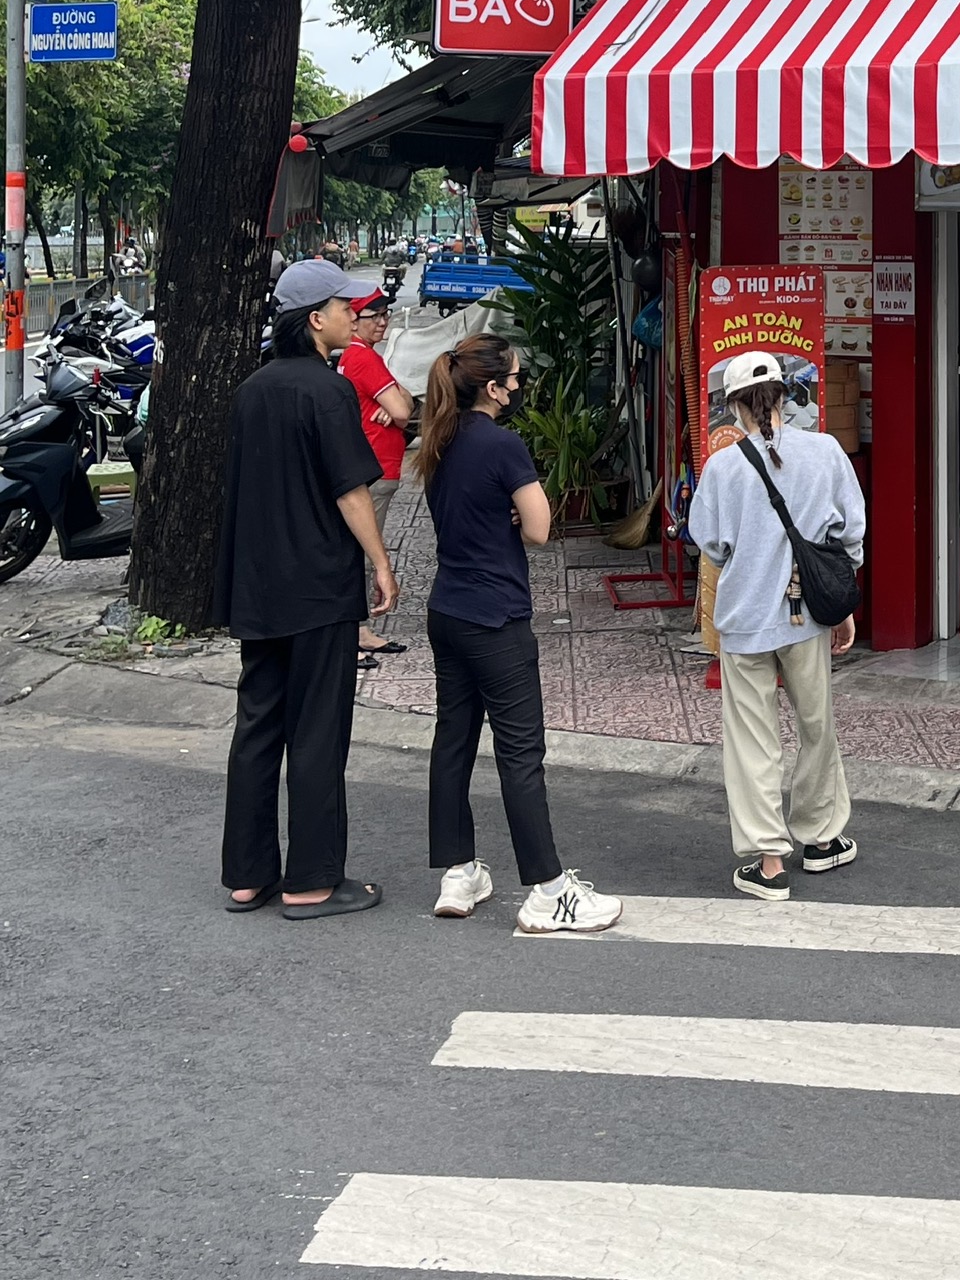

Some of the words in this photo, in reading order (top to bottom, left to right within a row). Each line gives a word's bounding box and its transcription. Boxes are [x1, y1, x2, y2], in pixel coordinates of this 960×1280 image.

[52, 9, 96, 24] ĐƯỜNG
[31, 26, 66, 51] NGUYỄN
[66, 28, 91, 49] CÔNG
[91, 32, 115, 48] HOAN
[736, 277, 769, 297] THỌ
[774, 271, 816, 291] PHÁT
[776, 295, 800, 303] KIDO
[723, 314, 748, 332] AN
[752, 311, 802, 331] TOÀN
[713, 331, 753, 352] DINH
[757, 329, 814, 352] DƯỠNG
